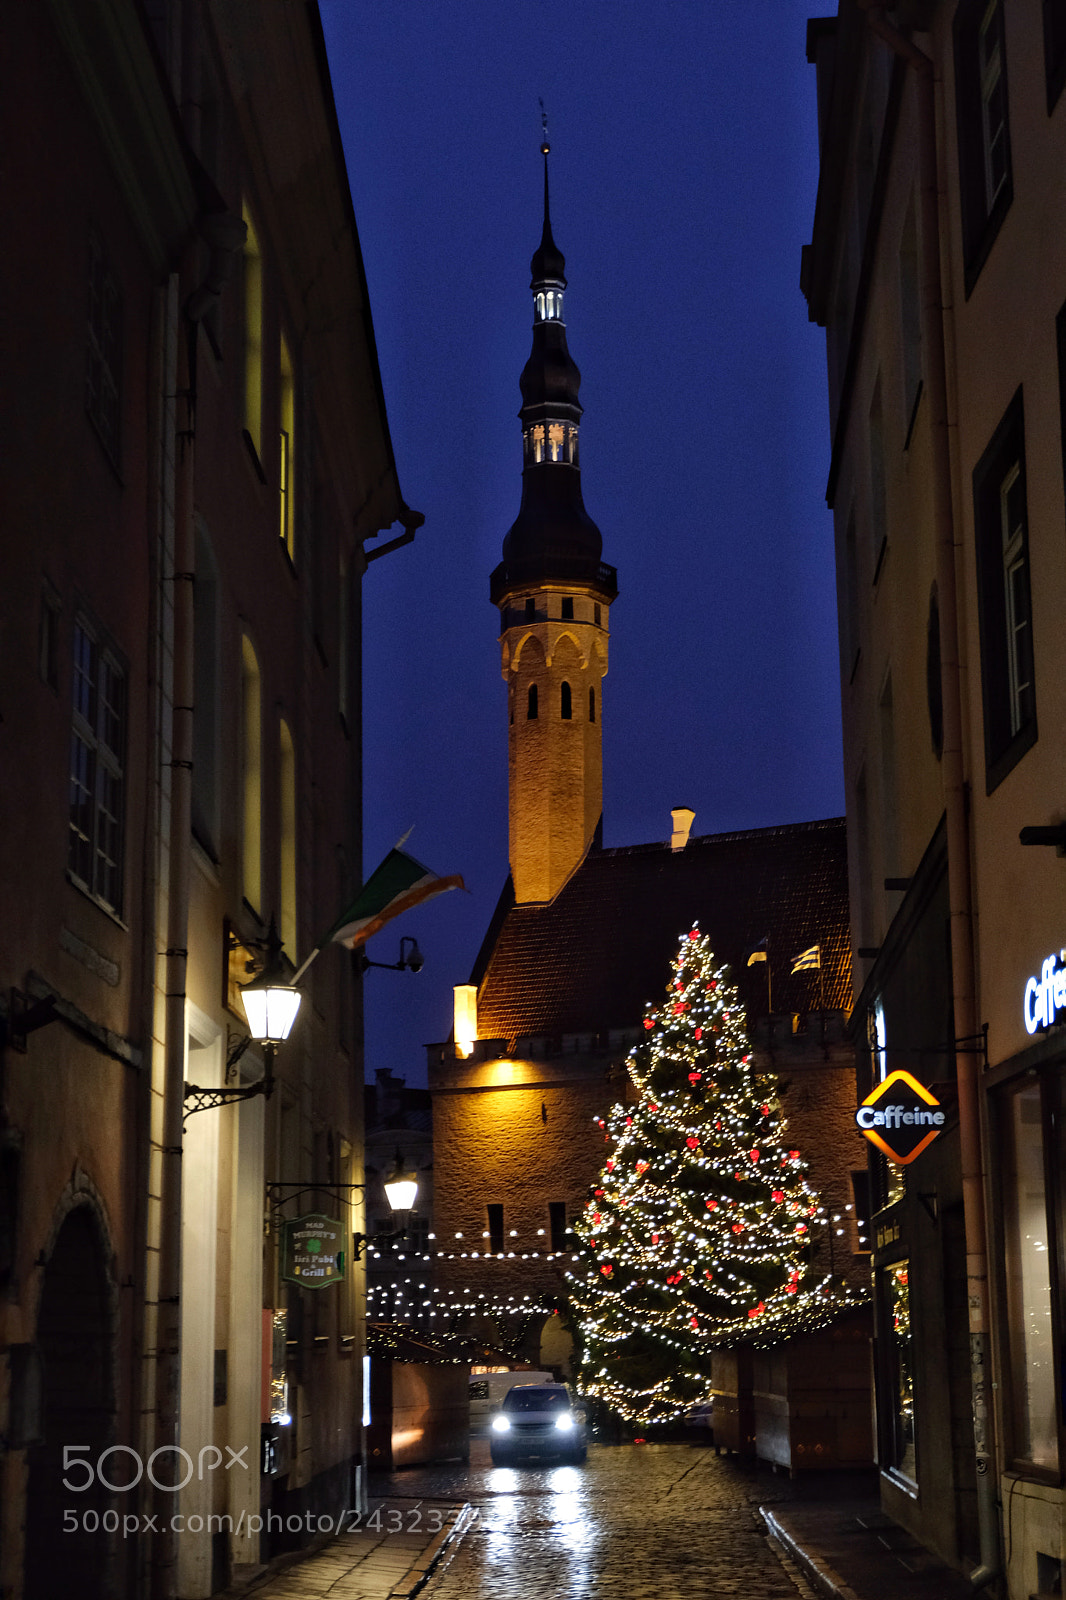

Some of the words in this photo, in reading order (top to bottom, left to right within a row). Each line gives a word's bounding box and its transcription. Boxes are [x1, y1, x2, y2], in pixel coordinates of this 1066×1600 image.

[856, 1105, 946, 1129] Caffeine
[311, 1255, 334, 1263] Pubi
[301, 1268, 325, 1277] Grill
